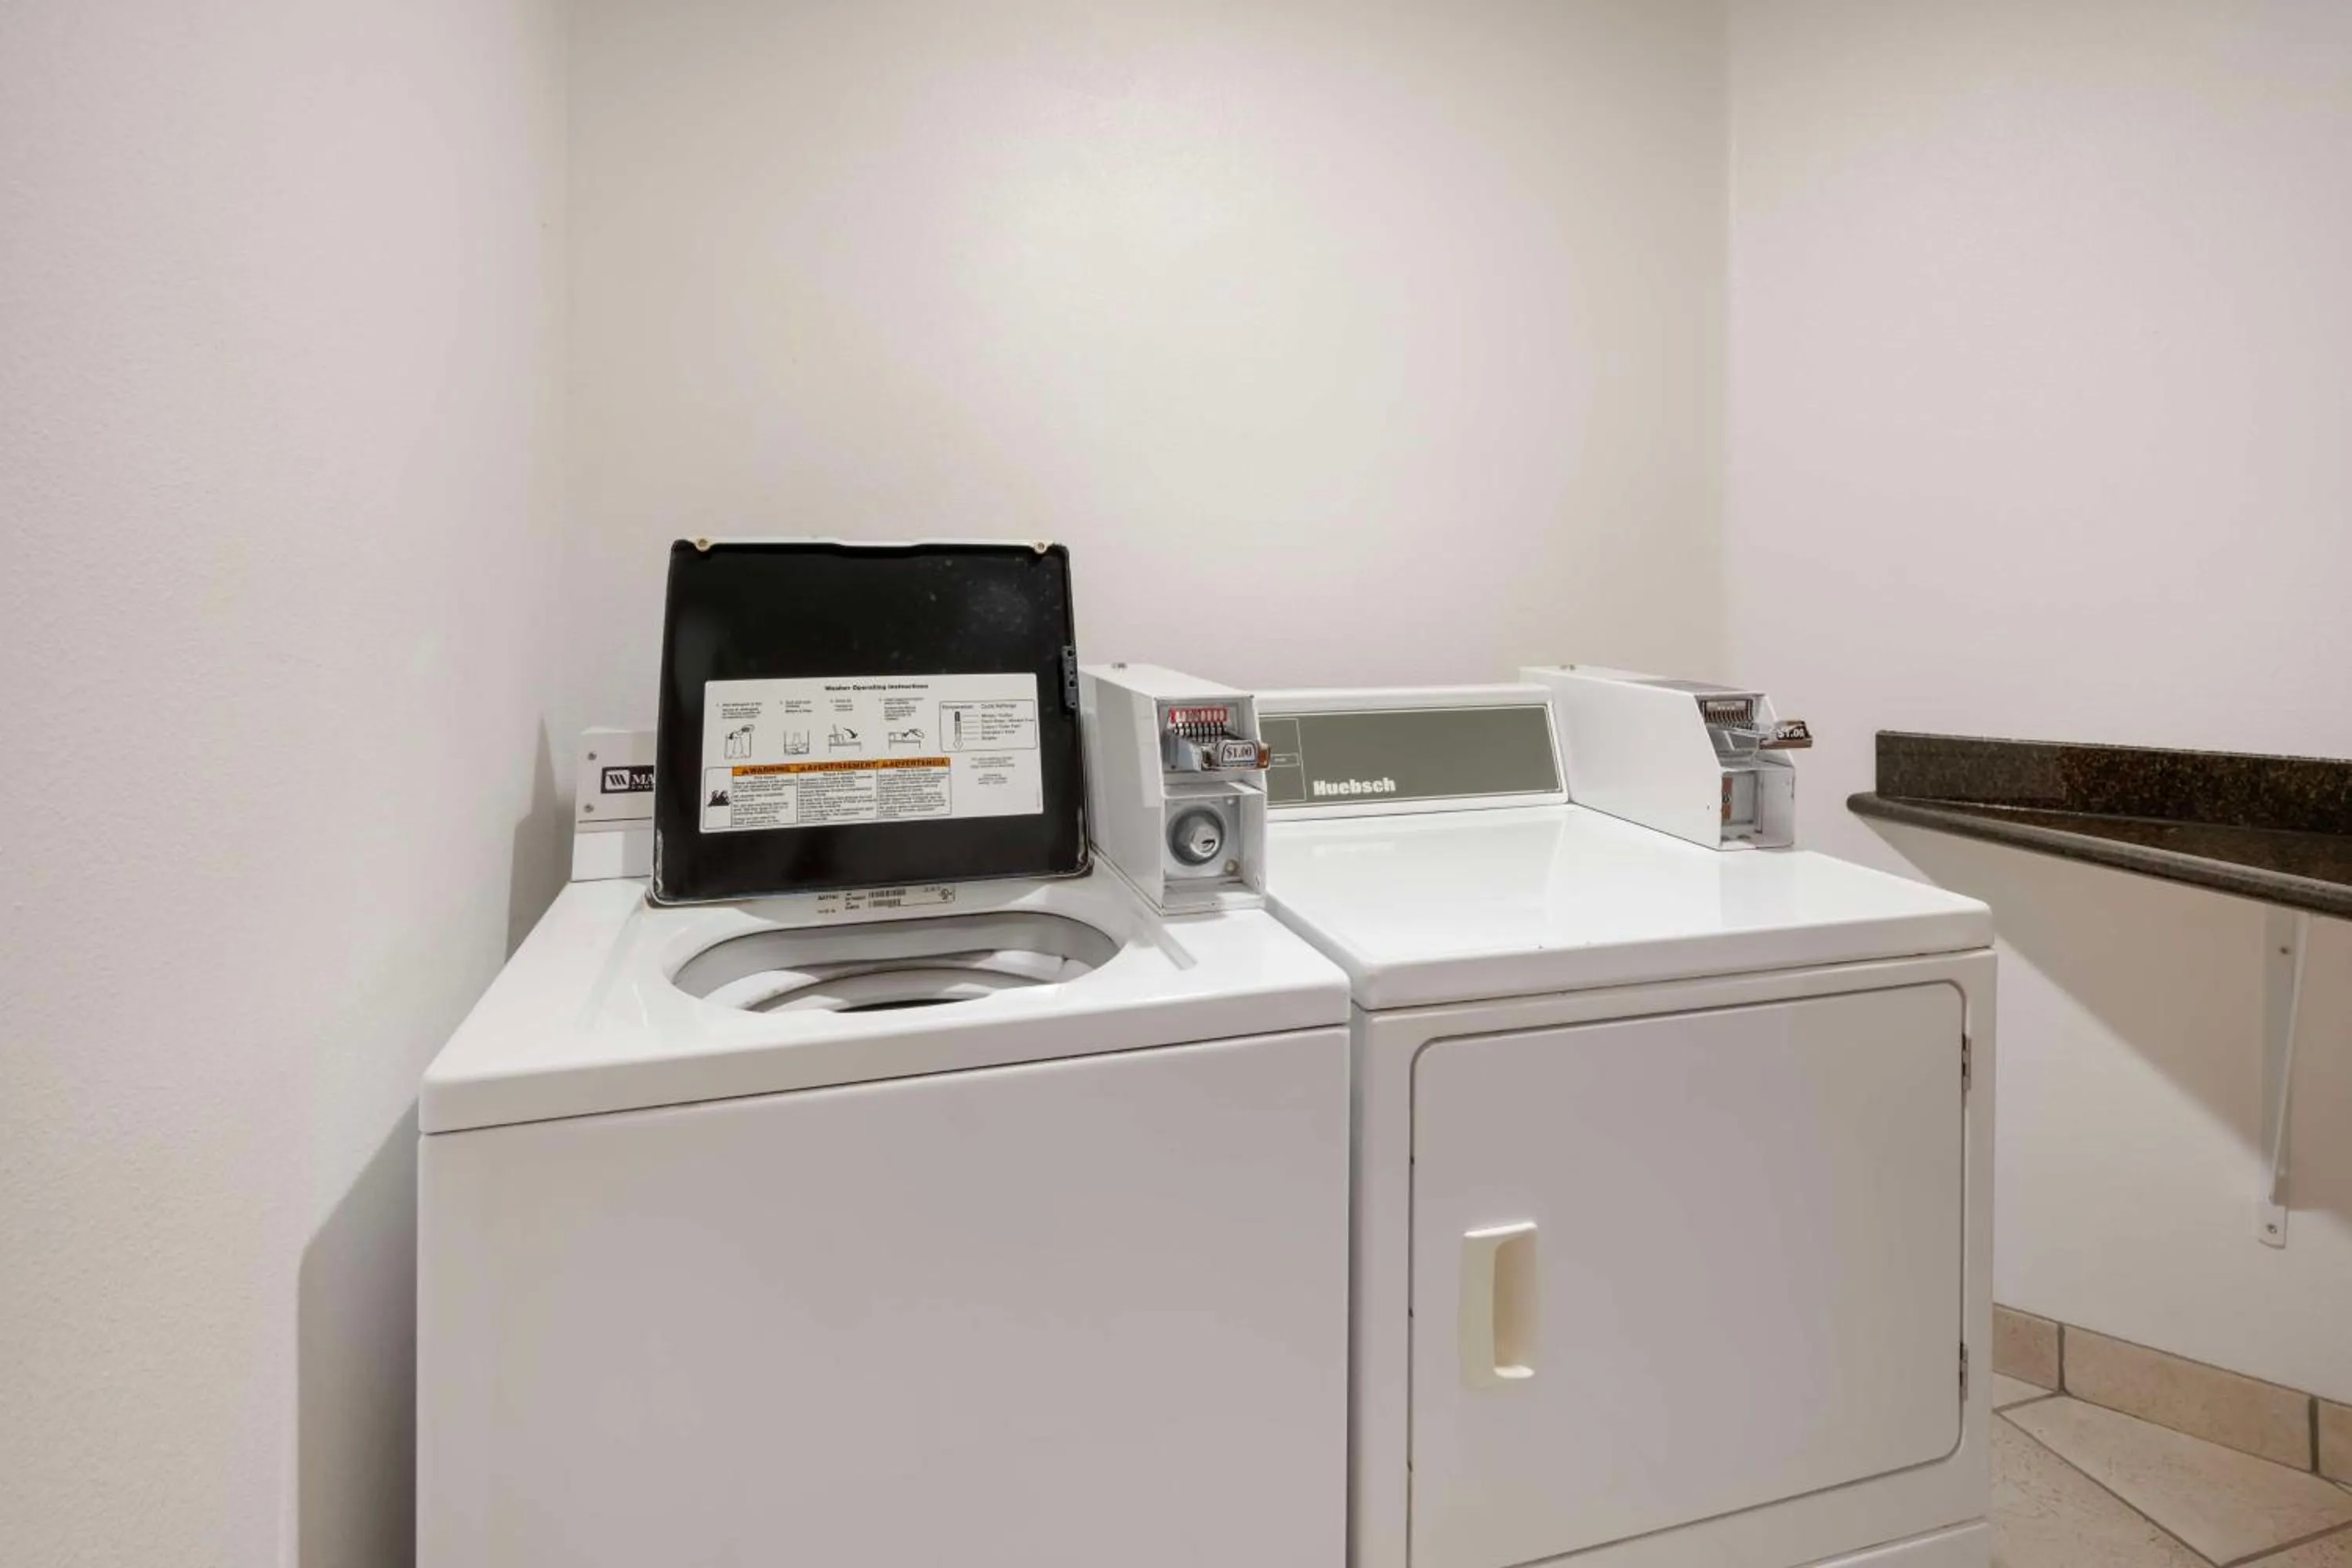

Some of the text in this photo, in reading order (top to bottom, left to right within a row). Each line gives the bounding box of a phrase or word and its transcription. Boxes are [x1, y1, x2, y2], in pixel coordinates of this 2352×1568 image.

[1225, 746, 1252, 758] $1.00
[749, 765, 791, 774] WARNING
[1313, 777, 1396, 796] Huebsch
